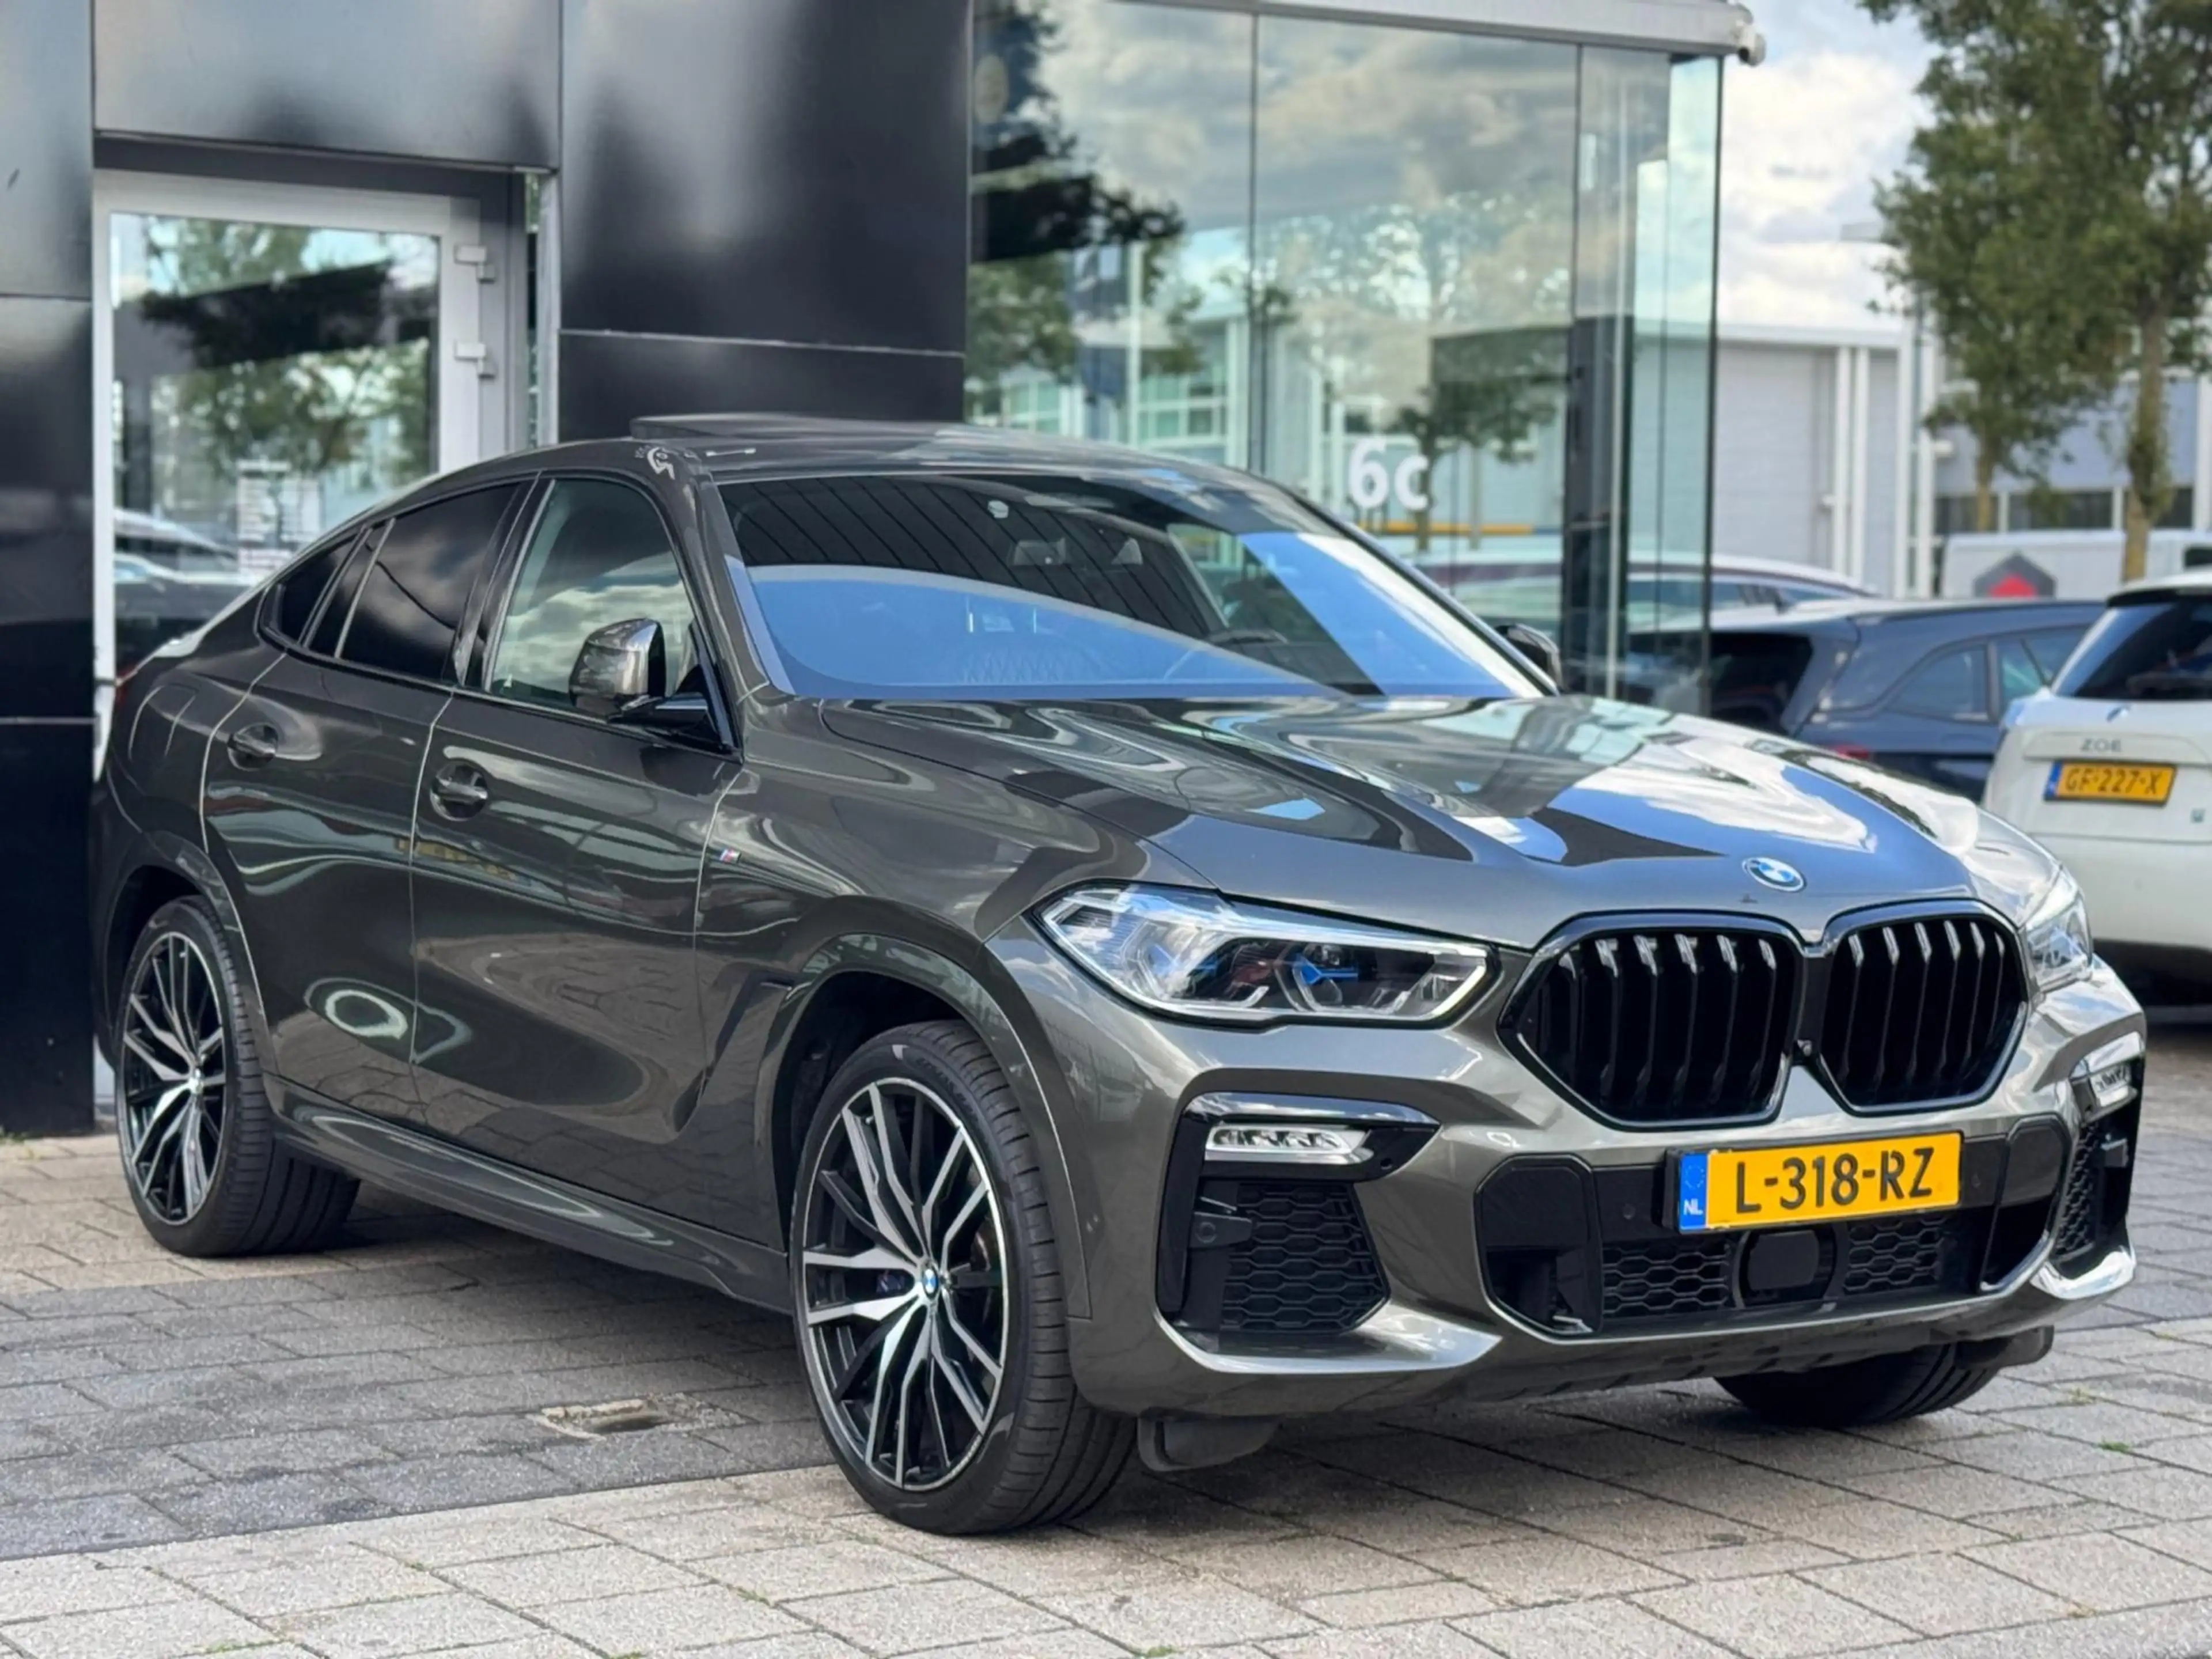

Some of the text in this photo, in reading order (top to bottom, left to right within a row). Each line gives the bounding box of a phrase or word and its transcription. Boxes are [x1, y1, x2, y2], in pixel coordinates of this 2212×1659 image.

[1348, 435, 1430, 511] 6c
[2080, 738, 2122, 752] ZOE
[2065, 767, 2164, 795] GF-227-X
[1683, 1146, 1934, 1215] NL L-318-RZ
